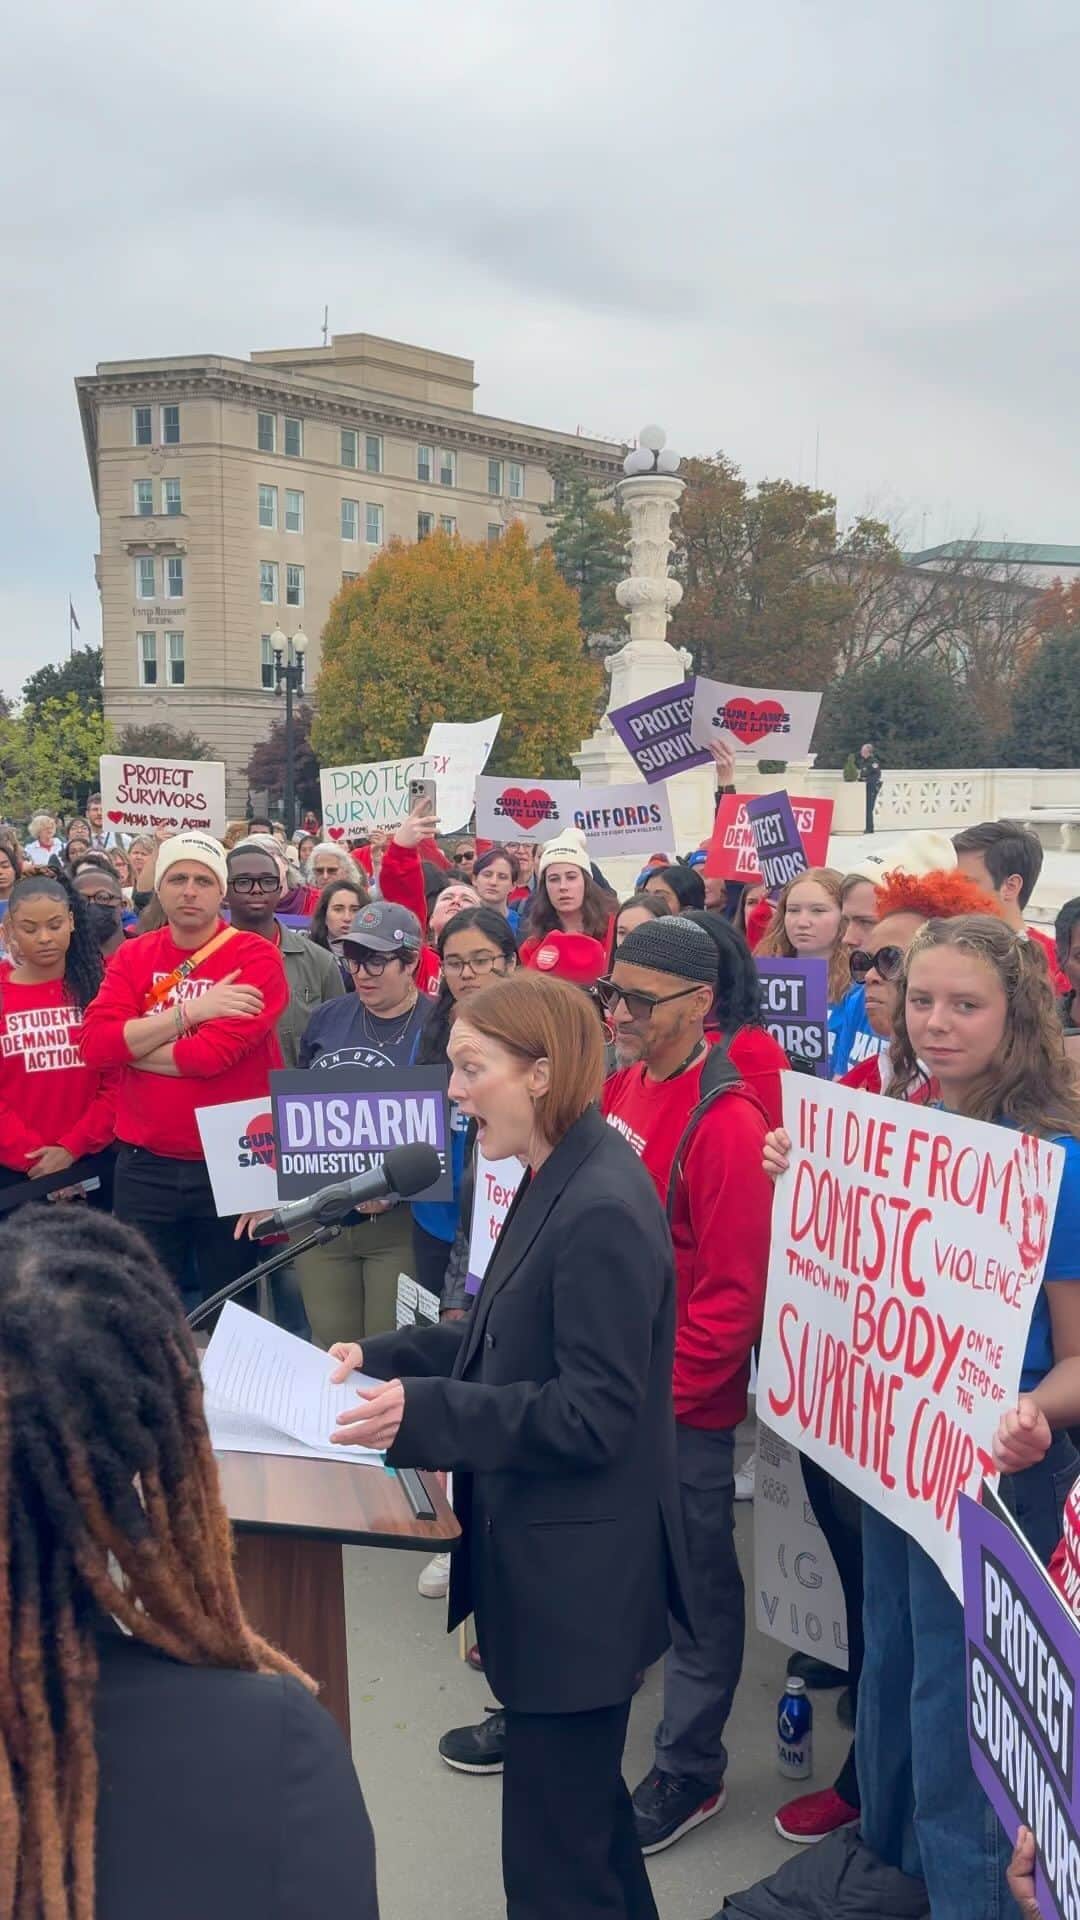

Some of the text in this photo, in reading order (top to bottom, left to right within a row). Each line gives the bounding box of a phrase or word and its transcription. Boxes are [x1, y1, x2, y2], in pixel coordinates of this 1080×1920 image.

[629, 697, 694, 741] PROTEC
[711, 717, 791, 734] SAVE LIVES
[716, 707, 791, 723] GUN LAWS
[636, 732, 703, 772] SURVIV
[123, 763, 194, 788] PROTECT
[330, 760, 430, 797] PROTECT
[115, 784, 207, 811] SURVIVORS
[495, 798, 558, 810] GUN LAWS
[493, 807, 560, 820] SAVE LIVES
[573, 803, 662, 830] GIFFORDS
[752, 814, 785, 848] TECT
[8, 1008, 82, 1032] STUDENT
[2, 1029, 67, 1055] DEMAND
[28, 1047, 84, 1070] ACTION
[285, 1098, 437, 1148] DISARM
[238, 1152, 274, 1168] SAV
[282, 1153, 366, 1175] DOMESTIC
[800, 1098, 1014, 1225] IF I DIE FROM
[935, 1238, 1025, 1309] VIOLENCE
[785, 1249, 1004, 1395] THROW MY BODY ON THE
[957, 1357, 1007, 1401] STEPS OF
[956, 1385, 975, 1414] THE
[768, 1302, 904, 1490] SUPREME
[905, 1397, 998, 1533] COURT
[984, 1560, 1074, 1776] PROTECT
[779, 1744, 804, 1764] AIN
[971, 1656, 1080, 1920] SURVIVORS
